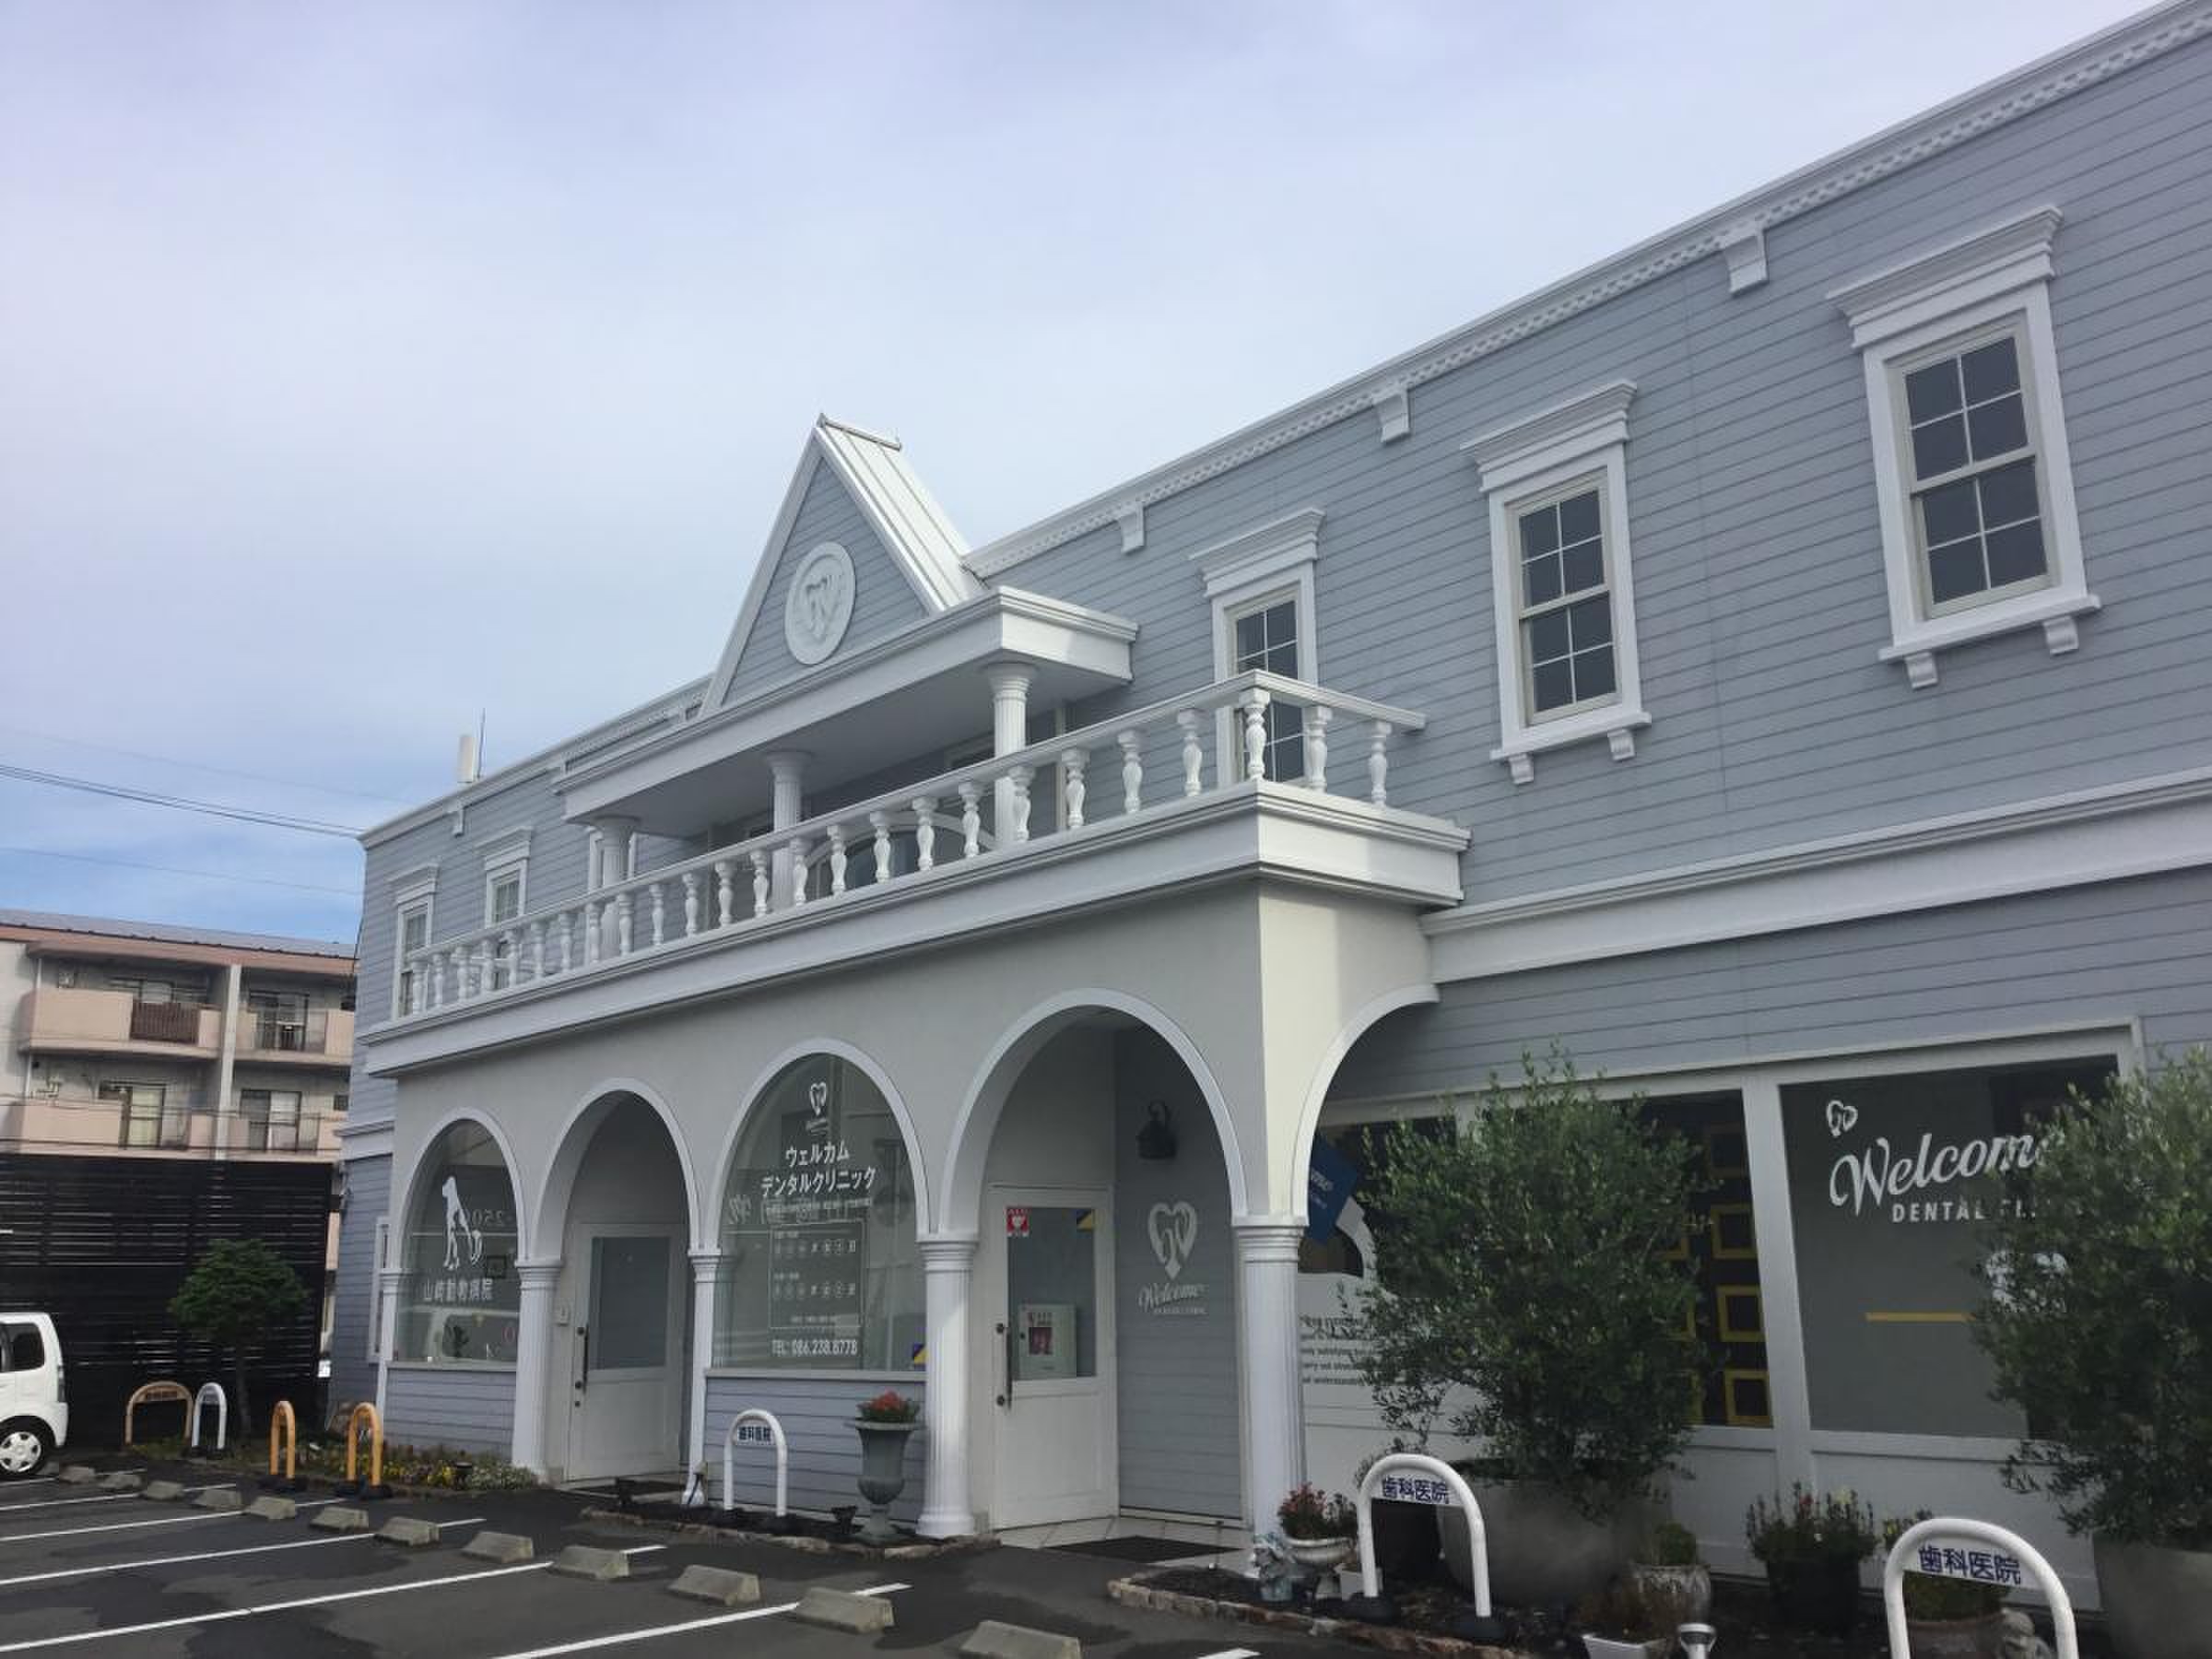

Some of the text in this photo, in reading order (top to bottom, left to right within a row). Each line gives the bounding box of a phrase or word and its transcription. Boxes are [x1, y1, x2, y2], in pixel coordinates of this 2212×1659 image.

[785, 1139, 850, 1168] ウェルカム
[760, 1166, 876, 1197] デンタルクリニック
[1829, 1133, 2042, 1217] Welcom
[1891, 1200, 1985, 1223] DENTAL
[1383, 1477, 1449, 1505] 歯科医院
[1918, 1544, 2021, 1585] 歯科医院
